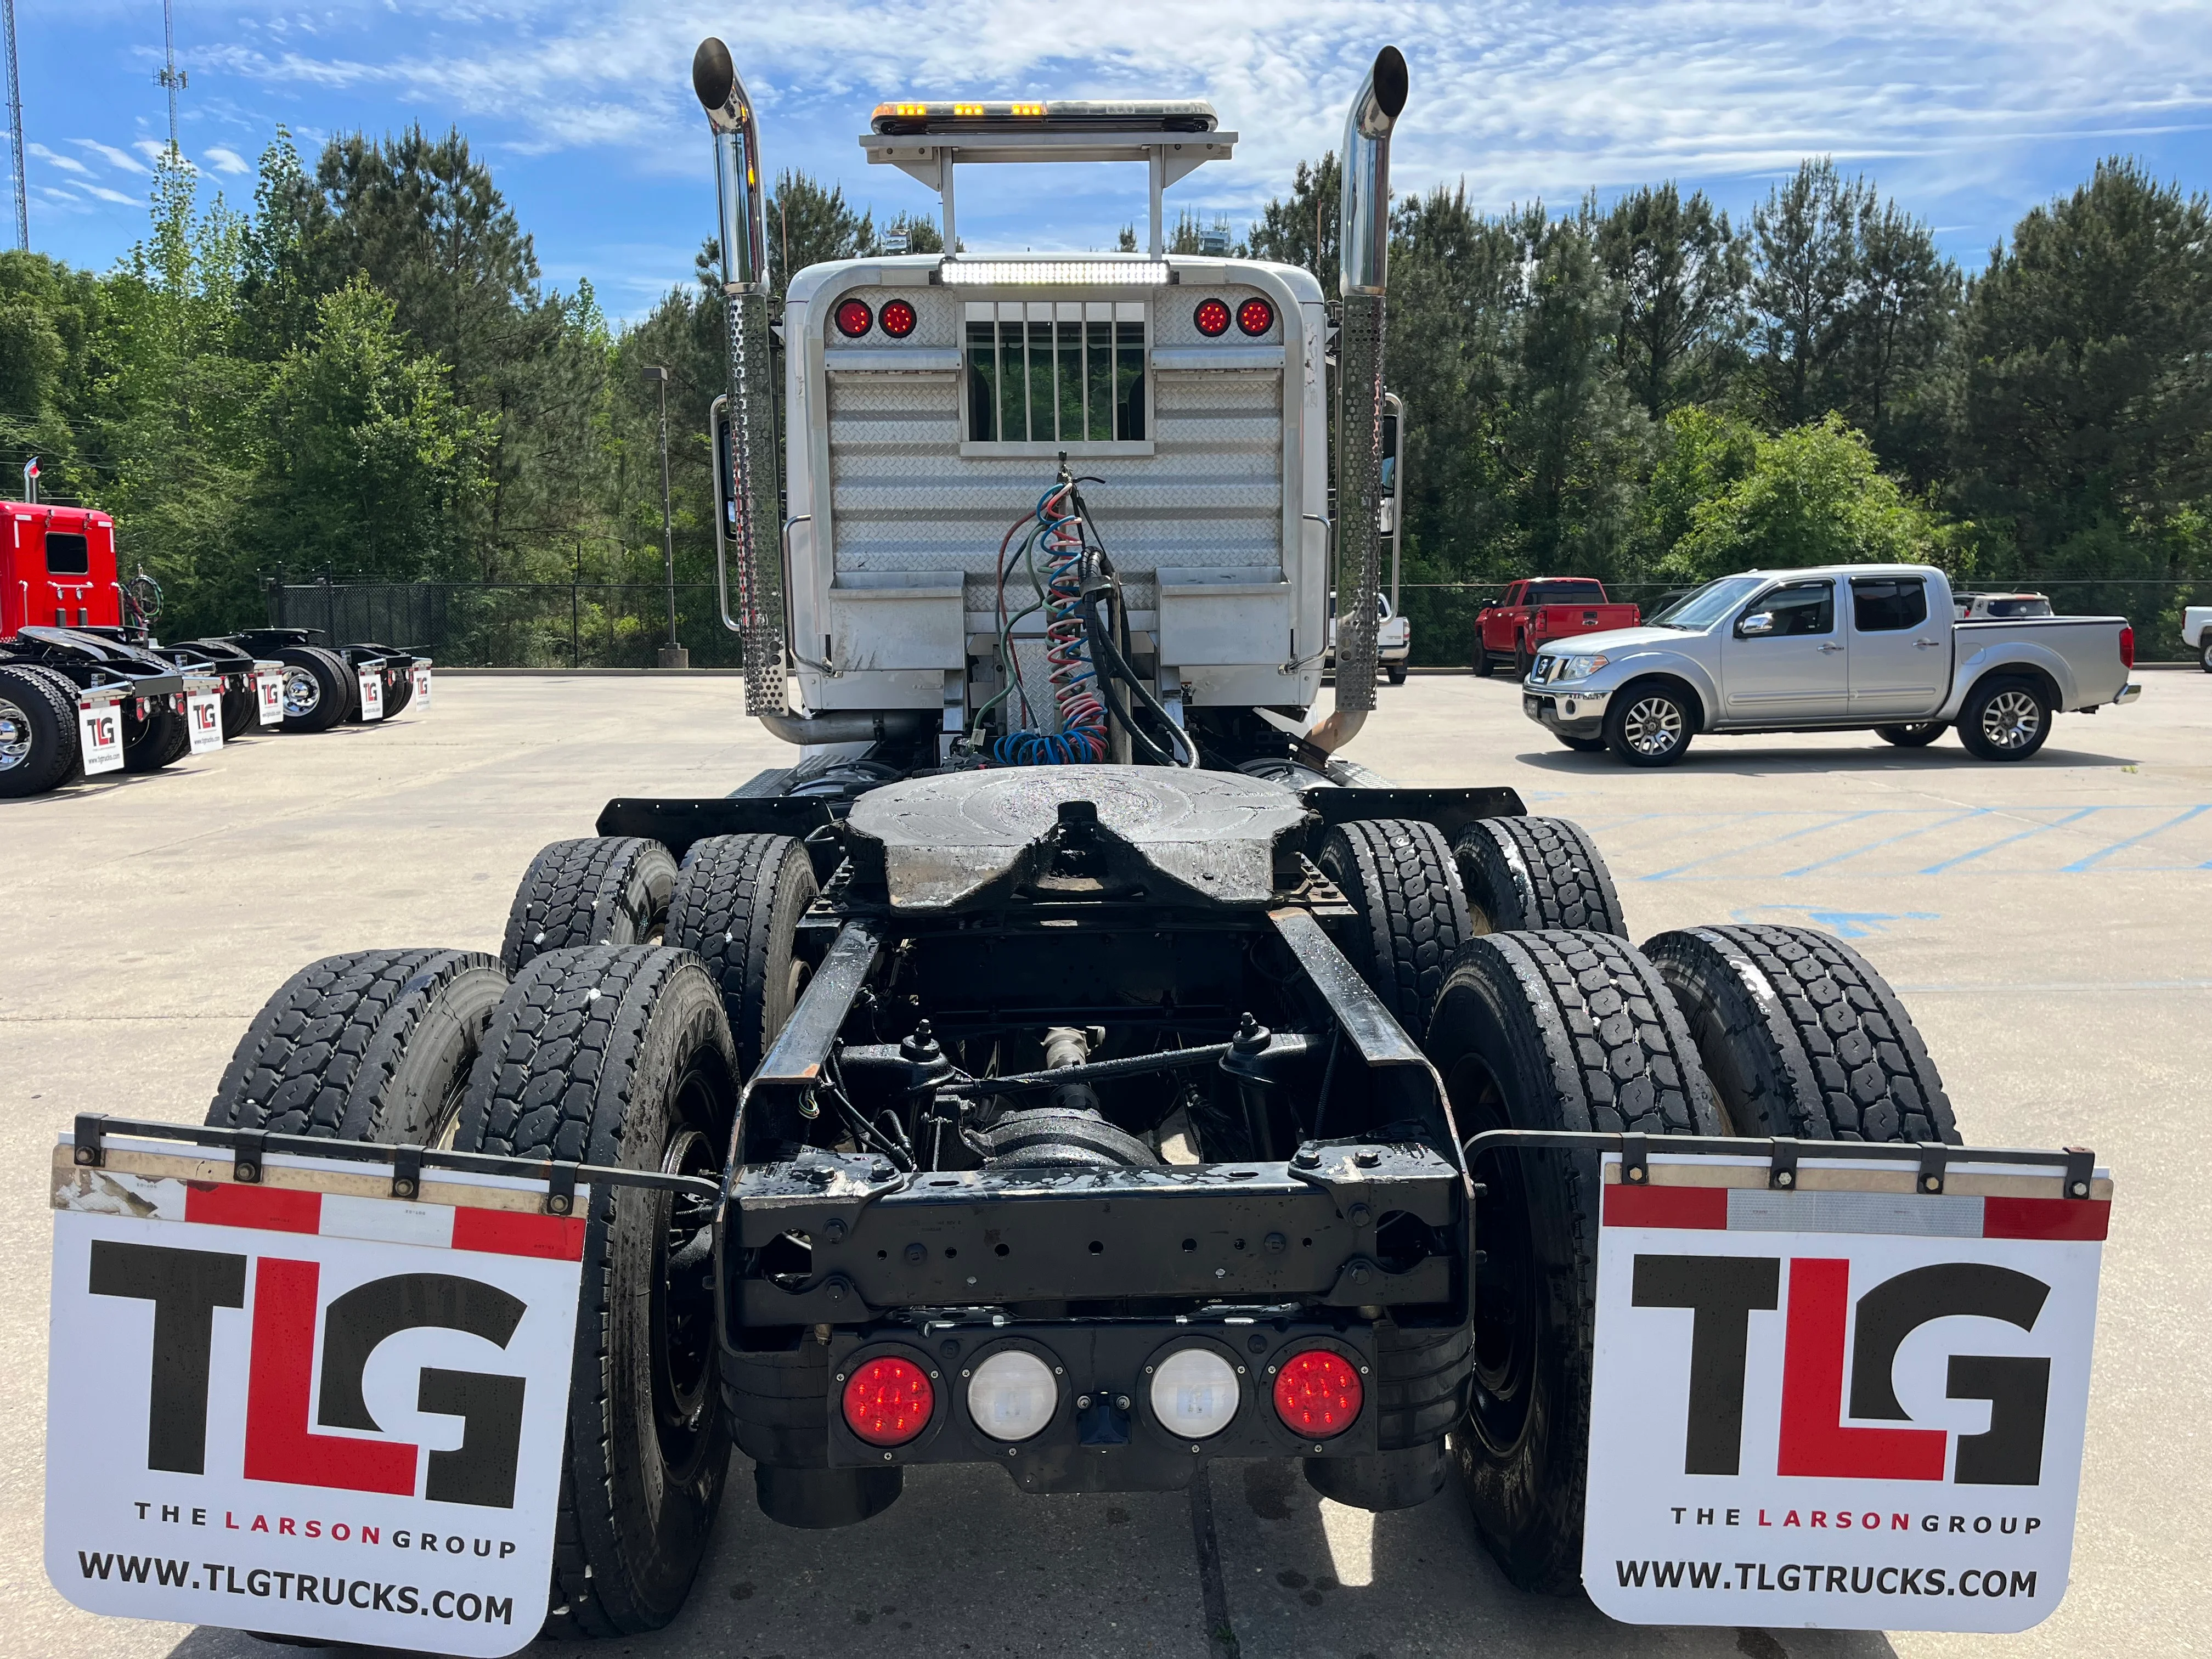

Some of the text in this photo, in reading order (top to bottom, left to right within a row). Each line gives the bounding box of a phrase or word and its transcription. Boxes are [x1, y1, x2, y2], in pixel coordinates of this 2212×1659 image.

[262, 684, 278, 705] TLG
[363, 682, 377, 702] TLG
[416, 677, 427, 695] TLG
[193, 703, 216, 729] TLG
[87, 717, 115, 747] TLG
[89, 1240, 527, 1509] TLG
[1632, 1254, 2051, 1486] TLG
[134, 1502, 206, 1526] THE
[1671, 1507, 1740, 1526] THE
[78, 1551, 513, 1625] WWW.TLGTRUCKS.COM
[1616, 1560, 2037, 1598] WWW.TLGTRUCKS.COM
